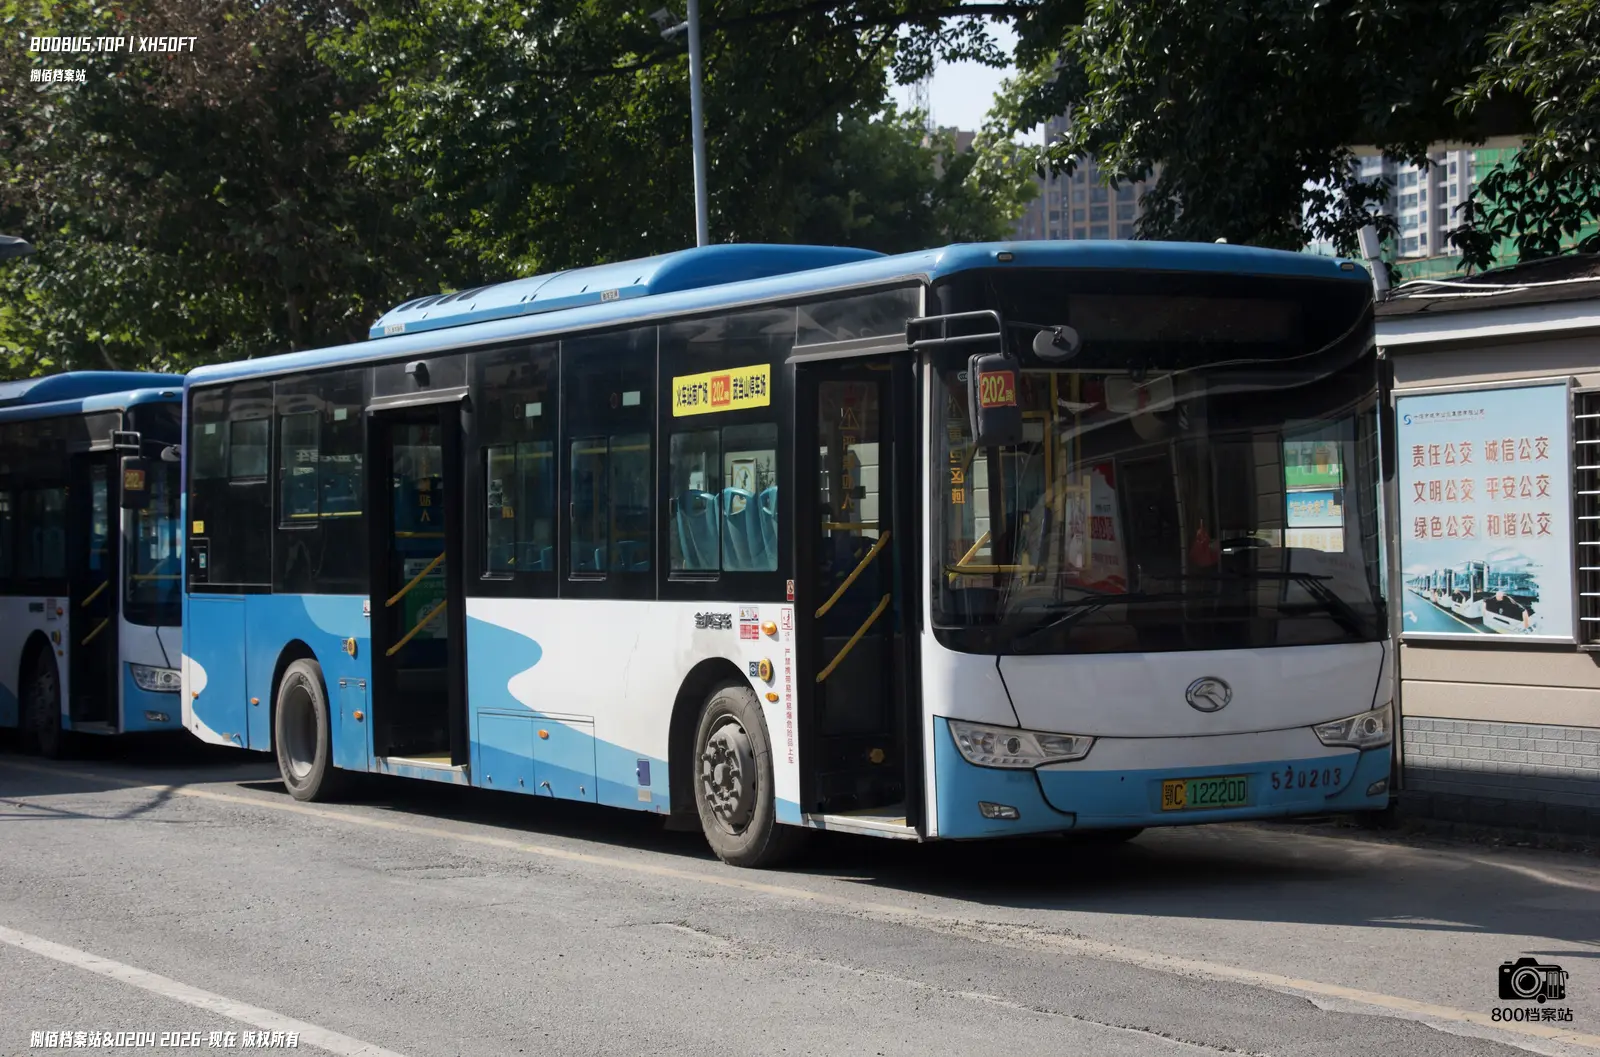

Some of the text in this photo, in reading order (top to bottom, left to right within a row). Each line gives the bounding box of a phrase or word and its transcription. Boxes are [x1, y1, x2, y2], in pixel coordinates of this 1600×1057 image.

[676, 382, 708, 407] 火车站南广场
[982, 375, 1015, 404] 202路
[1412, 436, 1549, 468] 责任公交 诚信公交
[1413, 474, 1551, 503] 文明公交 平安公交
[1413, 512, 1552, 539] 绿色公交 和谐公交
[1271, 767, 1342, 790] 520203
[1165, 780, 1247, 806] 鄂C 12220D
